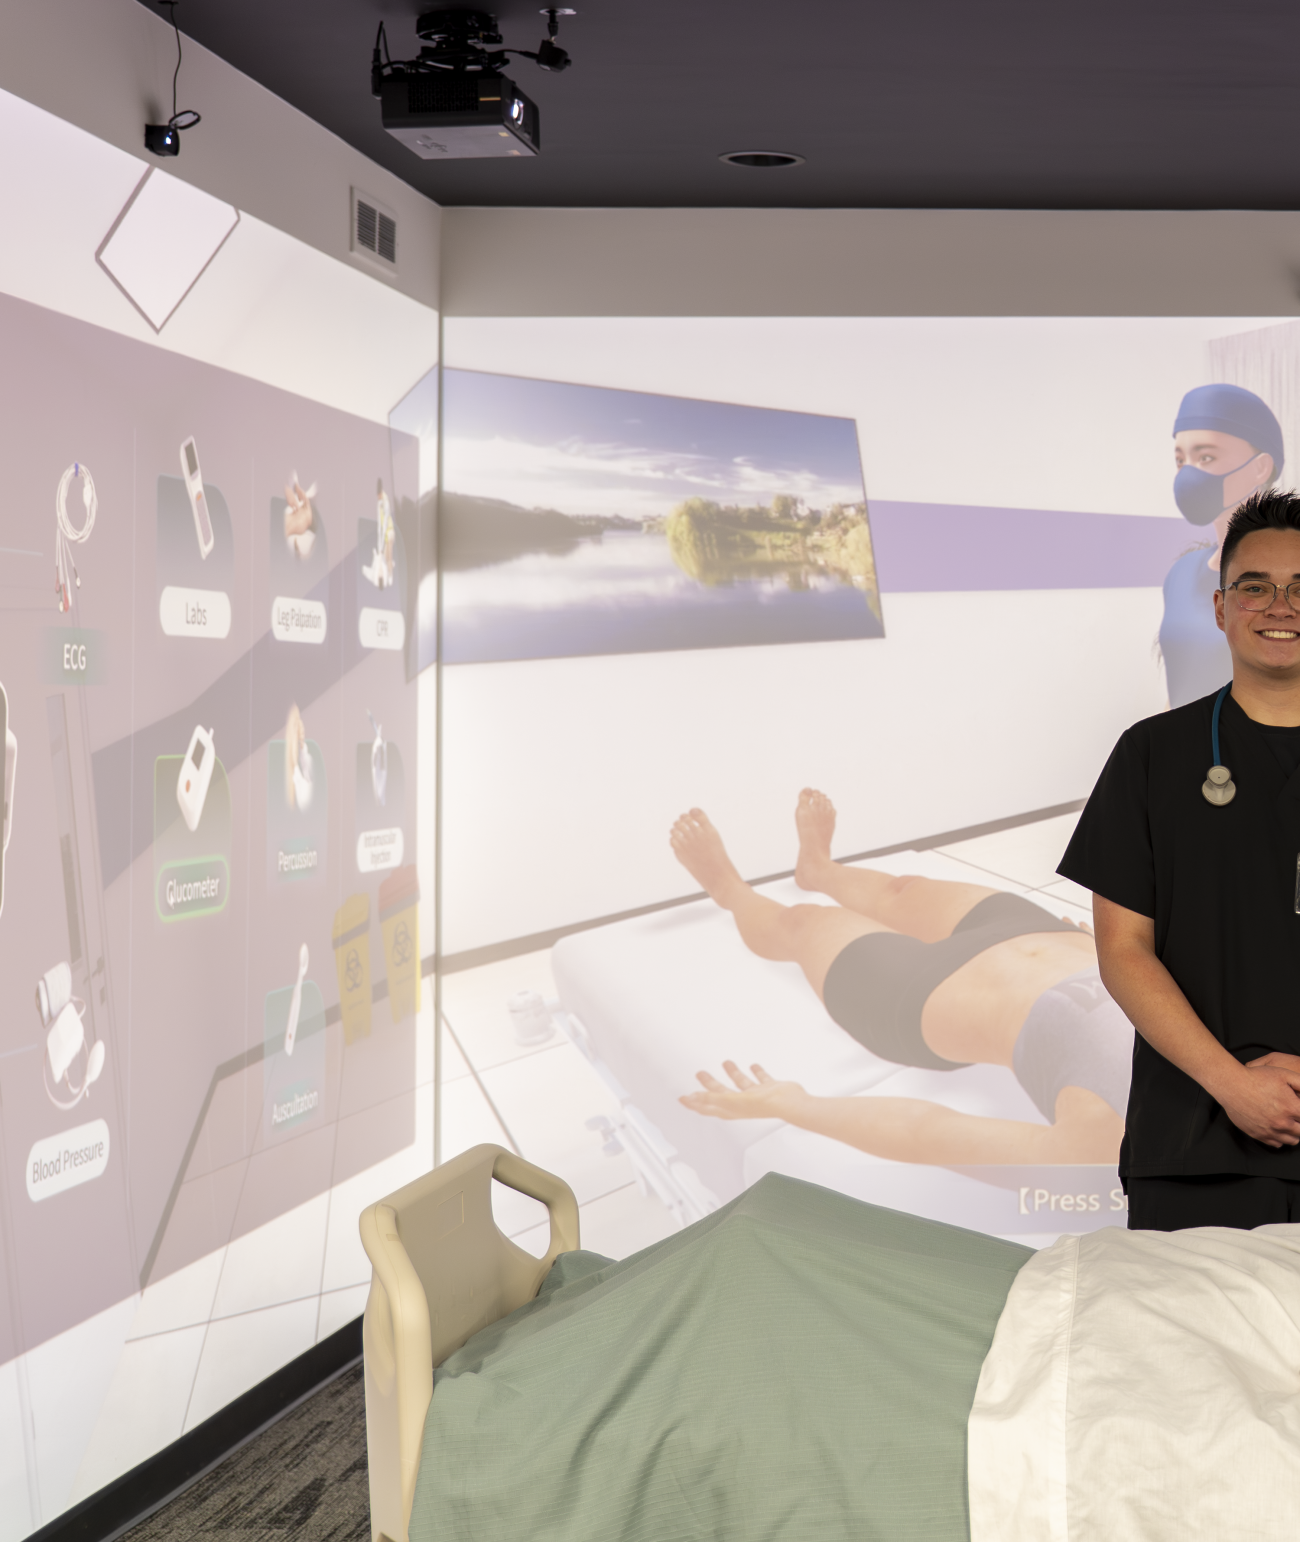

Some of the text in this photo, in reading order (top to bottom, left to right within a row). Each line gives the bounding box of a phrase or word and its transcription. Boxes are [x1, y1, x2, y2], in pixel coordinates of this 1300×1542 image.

[185, 602, 207, 627] Labs
[277, 606, 322, 633] Leg Palpation
[376, 619, 389, 637] CPR
[63, 643, 87, 671] ECG
[278, 846, 318, 873] Percussion
[166, 876, 220, 904] Glucometer
[272, 1088, 319, 1124] Auscultation
[32, 1141, 105, 1184] Blood Pressure
